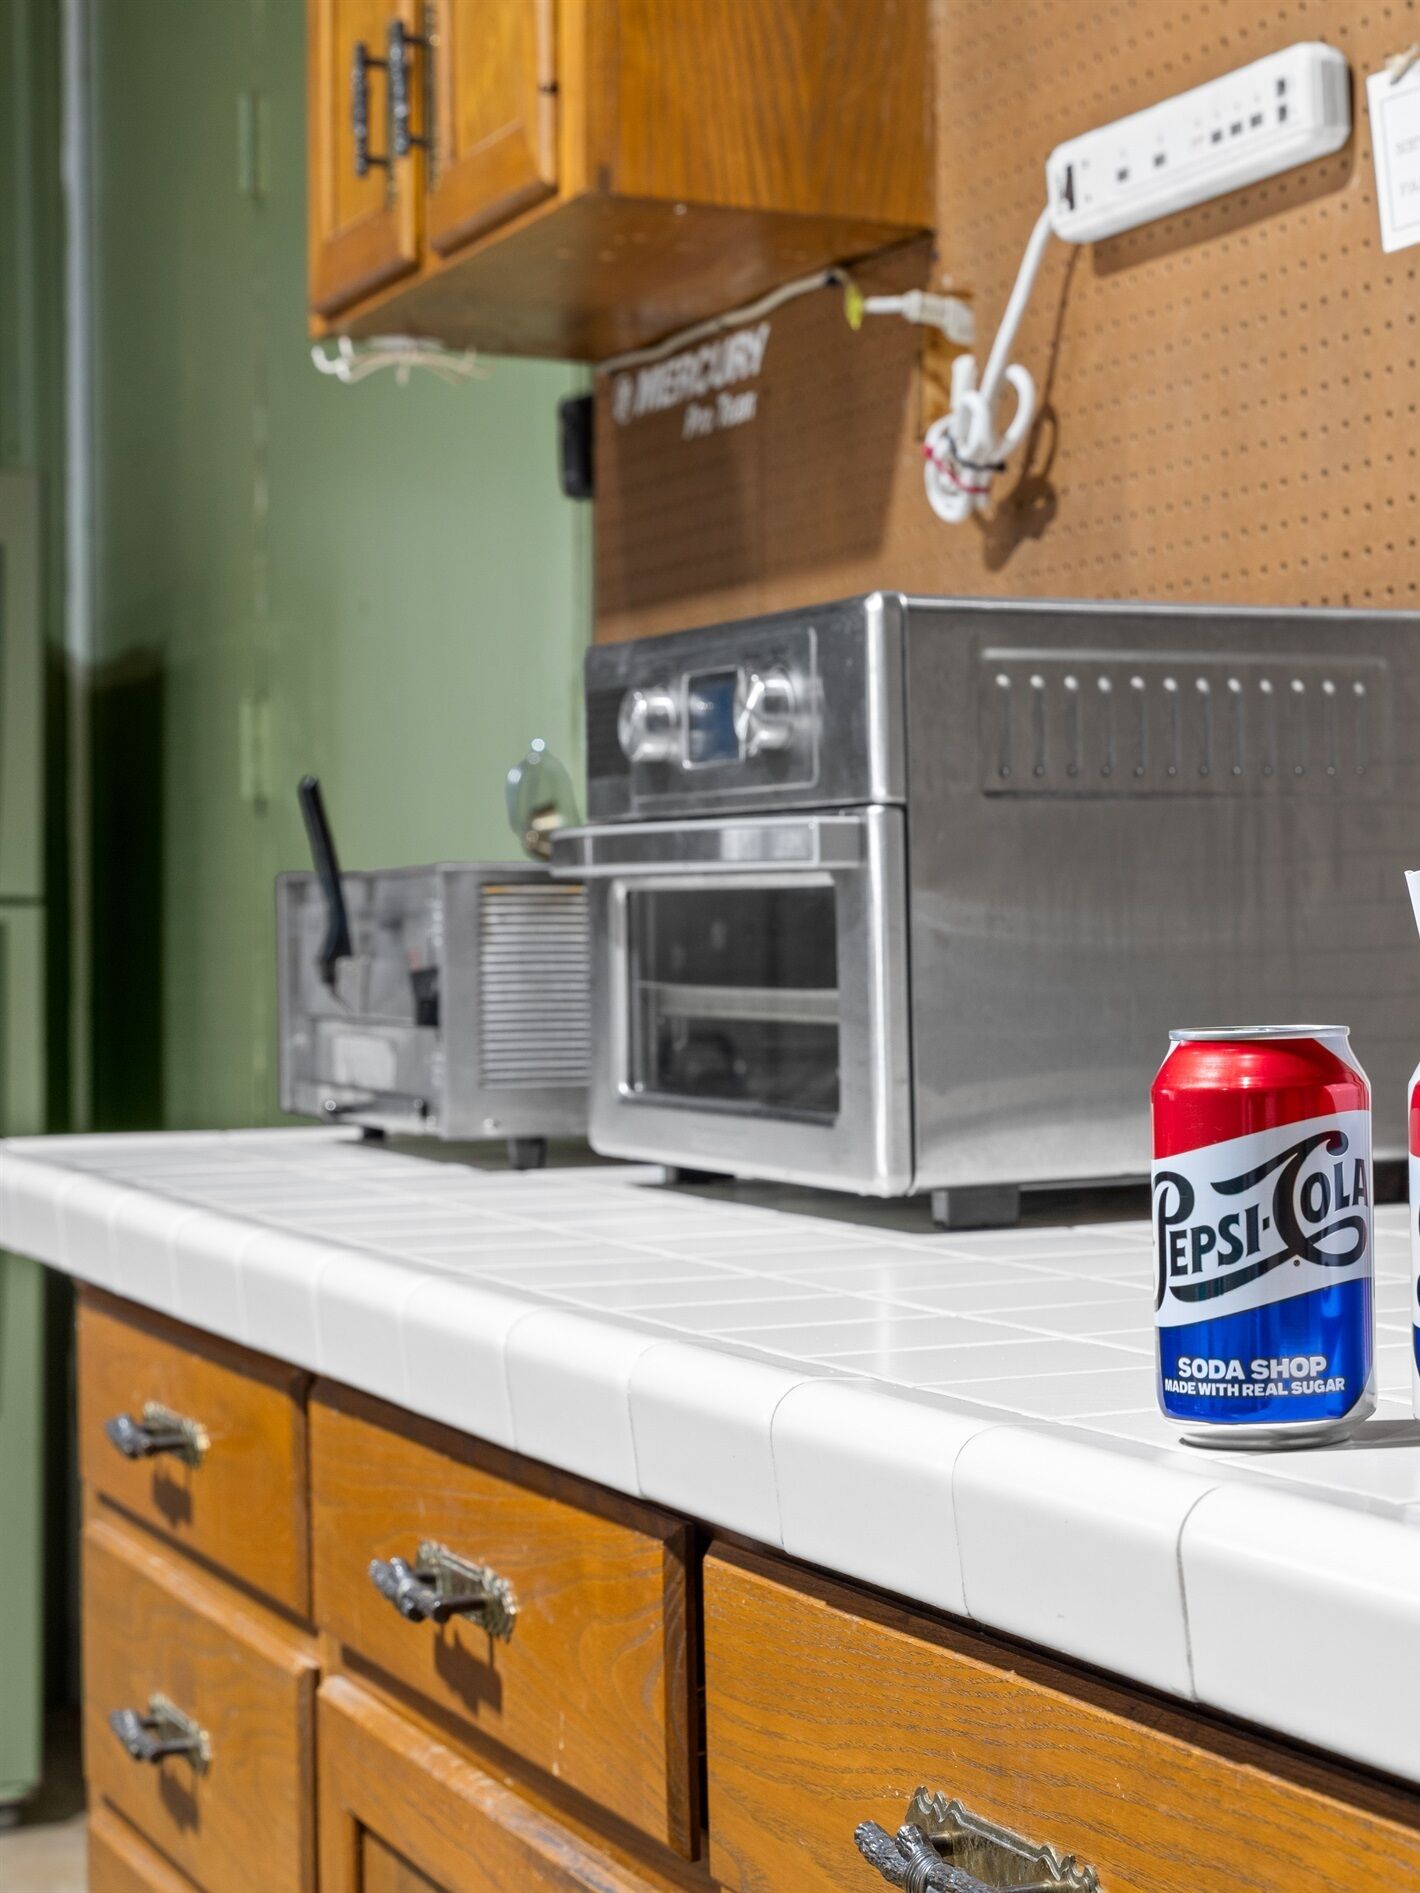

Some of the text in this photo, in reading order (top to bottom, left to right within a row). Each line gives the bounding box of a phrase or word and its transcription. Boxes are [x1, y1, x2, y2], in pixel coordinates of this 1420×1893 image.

[634, 322, 770, 416] MERCURY
[1178, 1356, 1327, 1379] SODA SHOP
[1164, 1377, 1345, 1396] MADE WITH REAL SUGAR
